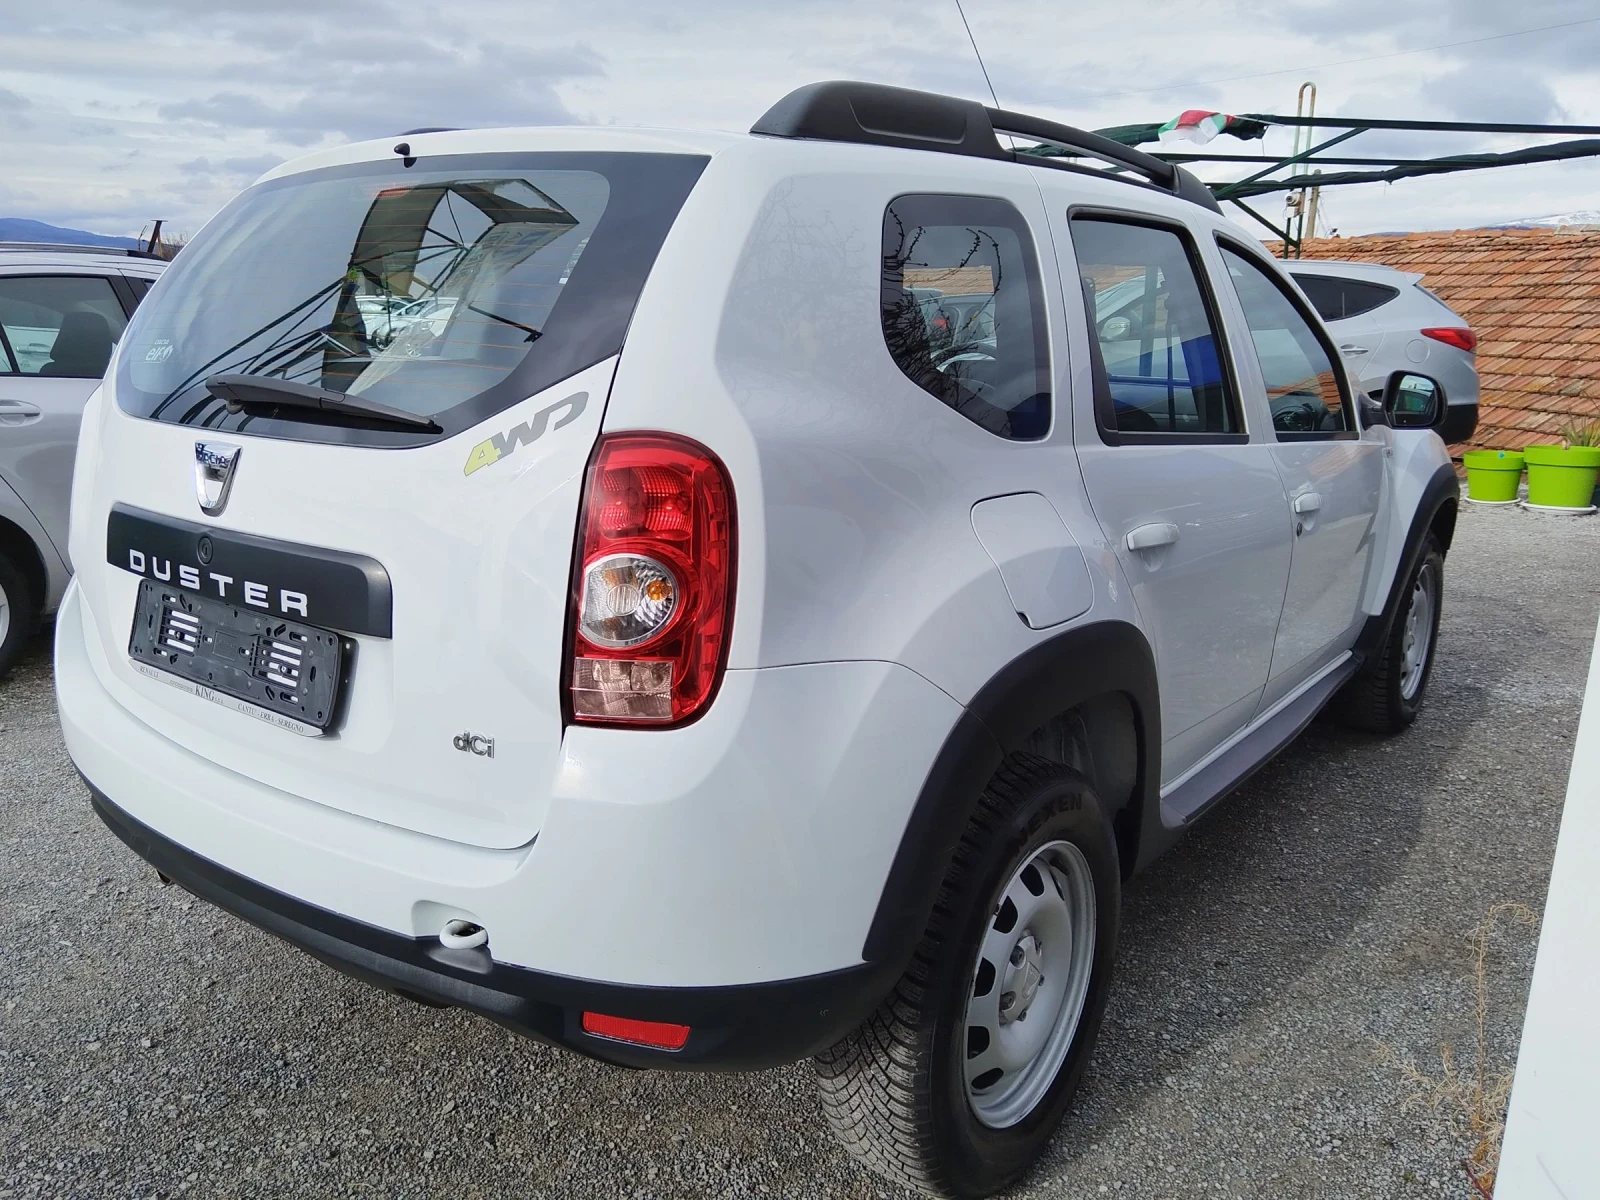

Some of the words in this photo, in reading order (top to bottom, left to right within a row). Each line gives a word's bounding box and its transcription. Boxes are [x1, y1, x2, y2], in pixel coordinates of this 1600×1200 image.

[464, 391, 590, 477] 4WD
[129, 548, 308, 617] DUSTER
[195, 684, 215, 701] KING
[453, 731, 495, 759] dCi
